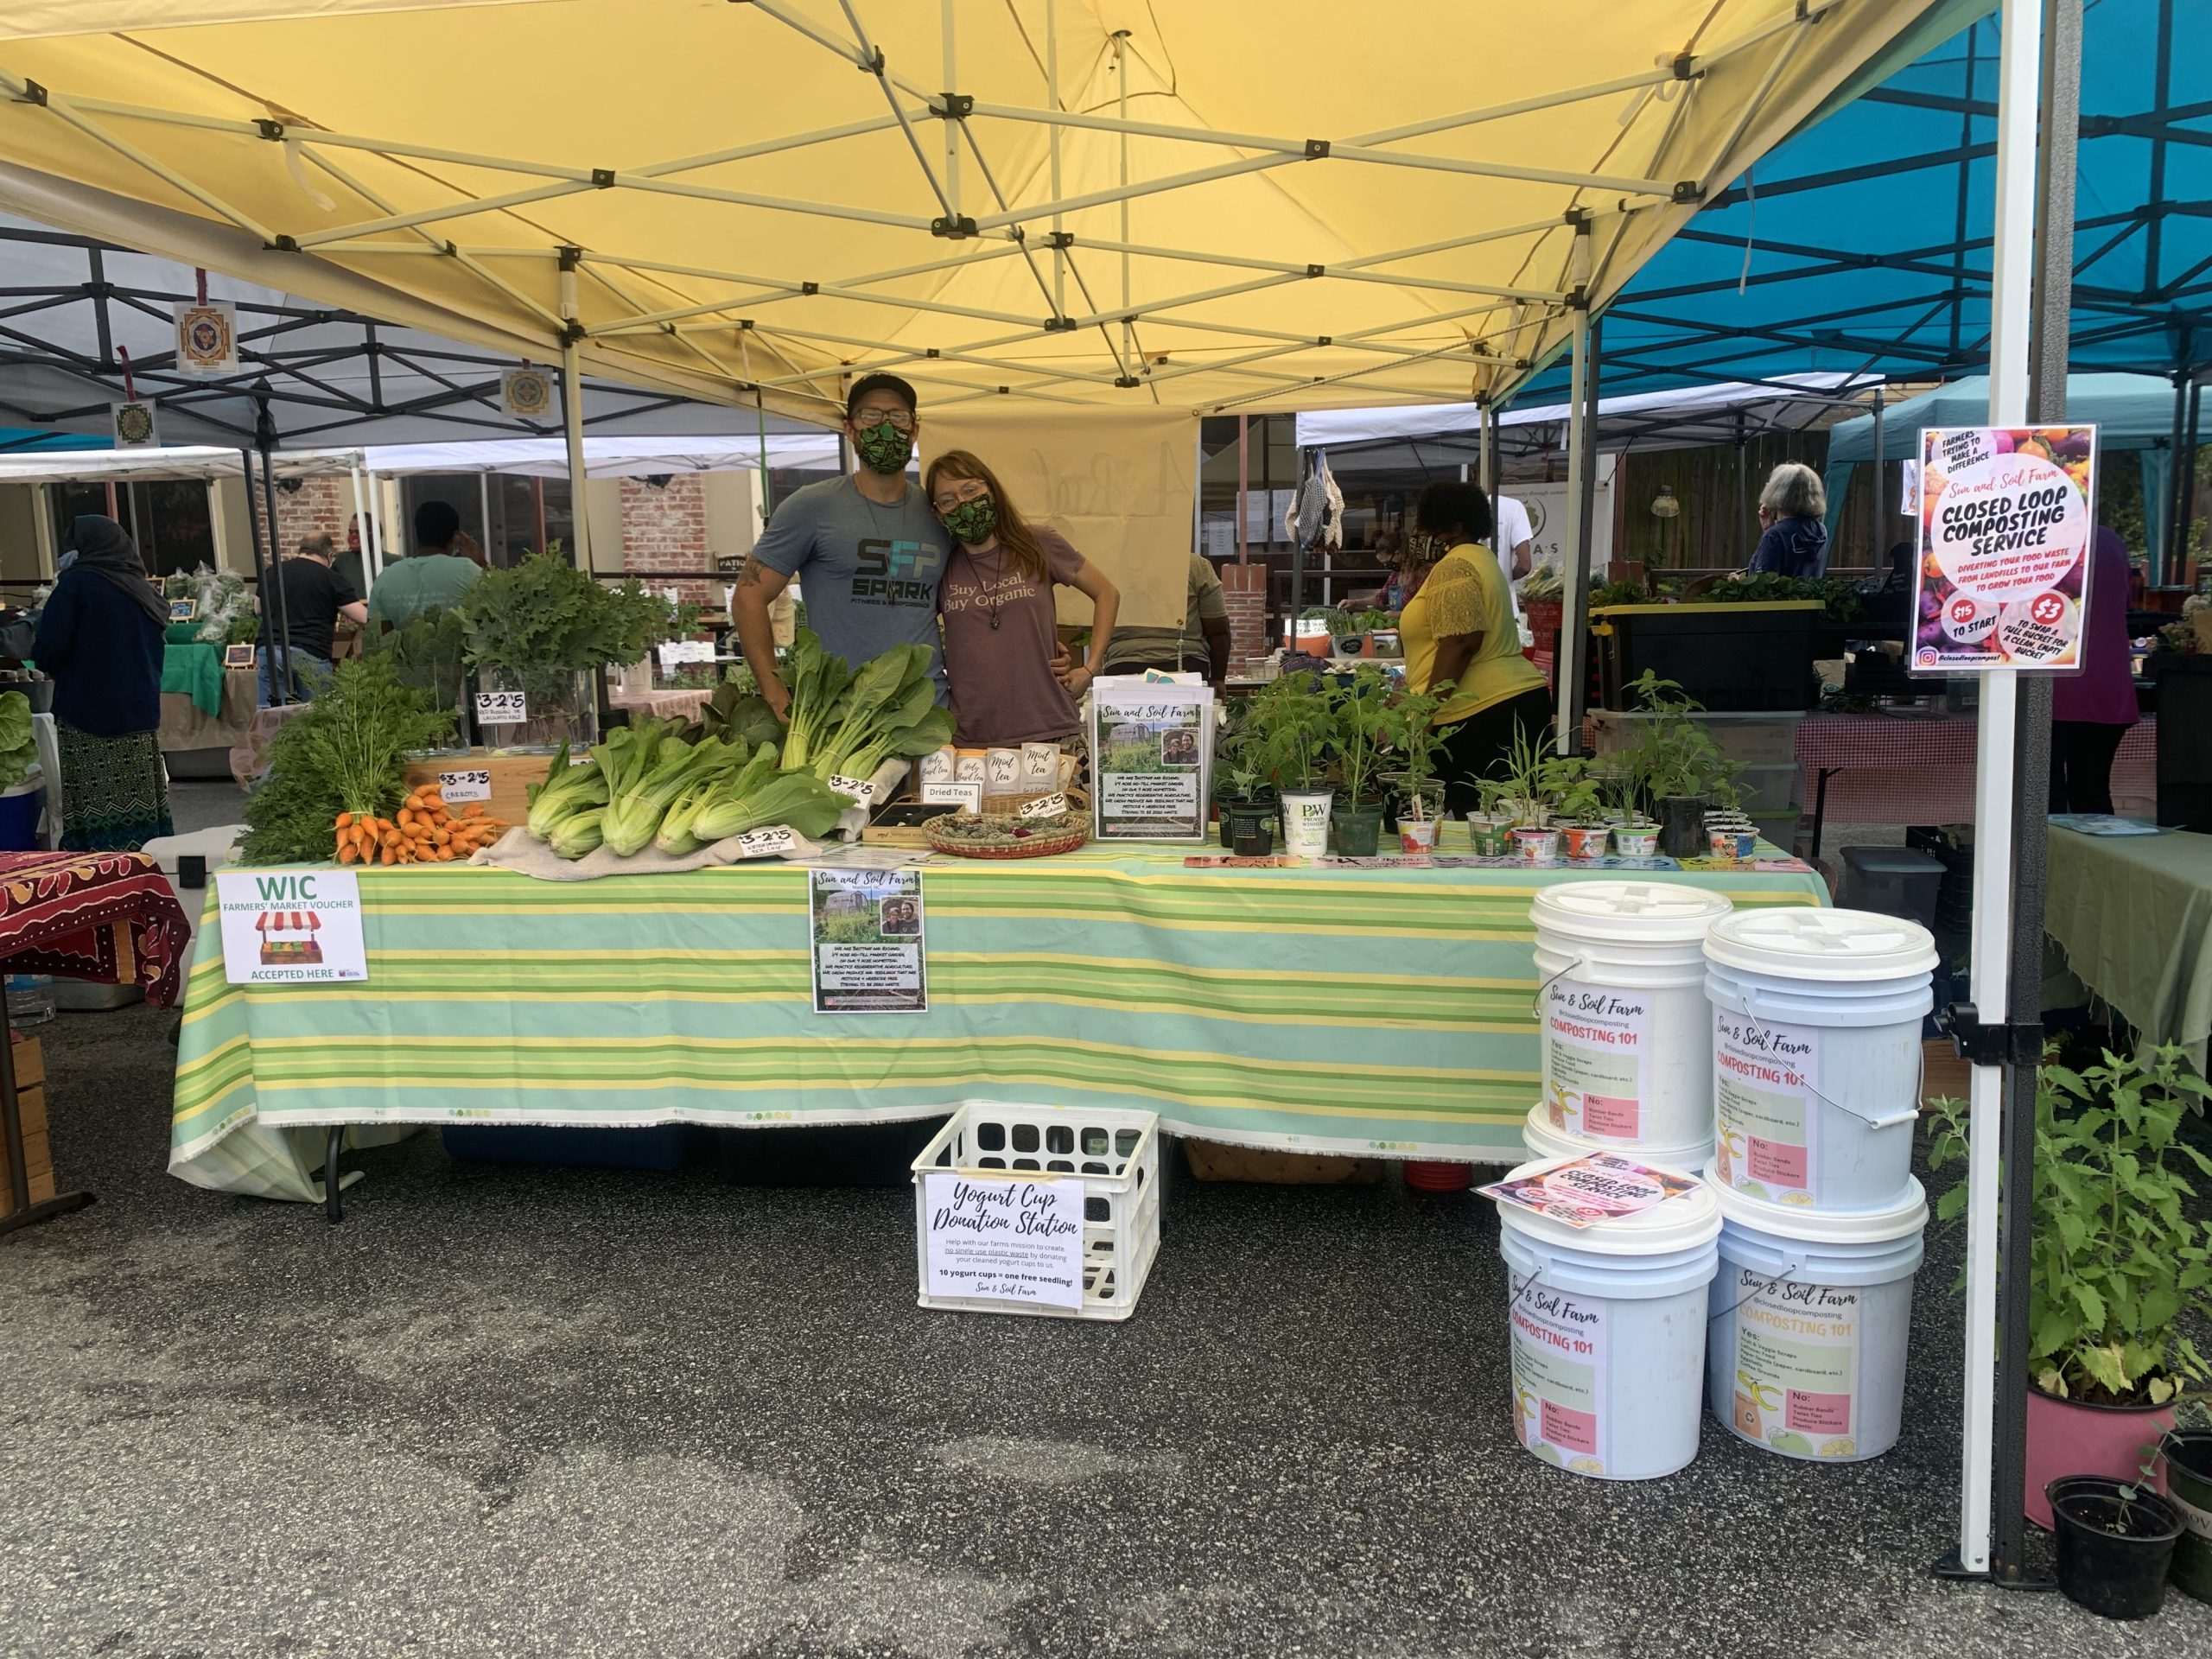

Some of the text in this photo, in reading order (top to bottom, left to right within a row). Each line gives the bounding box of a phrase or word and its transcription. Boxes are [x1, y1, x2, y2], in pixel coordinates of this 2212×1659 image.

[1942, 430, 1974, 448] FARMERS
[1942, 437, 1980, 457] TRYING TO
[1948, 451, 1989, 474] DIFFERENCE
[1951, 451, 1970, 463] MAKE
[1949, 468, 2059, 499] Sun and Soil Farm
[1942, 486, 2067, 524] CLOSED LOOP
[1943, 506, 2065, 543] COMPOSTING
[1971, 527, 2046, 556] SERVICE
[855, 538, 941, 580] SFP
[1958, 548, 2069, 573] DIVERTING YOUR FOOD WASTE
[1958, 574, 1978, 584] FROM
[1980, 569, 2018, 581] LANDFILLS
[2033, 563, 2050, 572] OUR
[2051, 560, 2071, 569] FARM
[1988, 580, 2011, 590] GROW
[2013, 577, 2033, 586] YOUR
[2035, 574, 2055, 583] FOOD
[852, 578, 932, 601] SPARK
[944, 599, 969, 613] Buy
[975, 586, 1036, 607] Organic
[1954, 605, 1973, 620] $15
[2034, 600, 2062, 619] $3
[1954, 616, 1997, 638] TO START
[2003, 625, 2069, 648] FULL BUCKET FOR
[2031, 622, 2051, 633] SWAP
[2014, 646, 2044, 659] BUCKET
[2037, 643, 2063, 656] EMPTY
[1103, 705, 1195, 718] Sun and Soil Farm
[991, 756, 1014, 767] Mint
[1027, 750, 1051, 760] Mint
[995, 770, 1010, 782] tea
[1031, 762, 1046, 775] tea
[256, 875, 317, 900] WIC
[818, 872, 916, 886] Sun and Soil Farm
[223, 902, 268, 912] FARMERS'
[310, 900, 353, 909] VOUCHER
[251, 970, 303, 980] ACCEPTED
[308, 969, 334, 978] HERE
[1550, 984, 1643, 1015] Sun & Soil Farm
[1558, 1008, 1630, 1028] @closedloopcomposting
[1550, 1016, 1637, 1045] COMPOSTING 101
[1718, 1015, 1812, 1054] Sun & Soil Farm
[1717, 1050, 1805, 1087] COMPOSTING 101
[1588, 1096, 1603, 1105] No:
[1753, 1139, 1768, 1150] No:
[953, 1182, 1058, 1215] Yogurt Cup
[933, 1208, 1077, 1237] Donation Station
[988, 1249, 1009, 1257] plastic
[1039, 1253, 1067, 1262] donating
[976, 1282, 989, 1292] Sun
[1000, 1283, 1016, 1295] Soil
[1018, 1285, 1037, 1296] Farm
[1021, 1273, 1038, 1281] free
[1039, 1275, 1073, 1287] seedling!
[1740, 1269, 1857, 1306] Sun & Soil Farm
[1526, 1290, 1532, 1302] &
[1535, 1292, 1560, 1317] Soil
[1562, 1302, 1599, 1324] Farm
[1753, 1296, 1842, 1319] @closedloopcomposting
[1738, 1304, 1852, 1337] COMPOSTING 101
[1512, 1308, 1592, 1355] COMPOSTING 101
[1741, 1326, 1760, 1341] Yes:
[1793, 1391, 1810, 1402] No:
